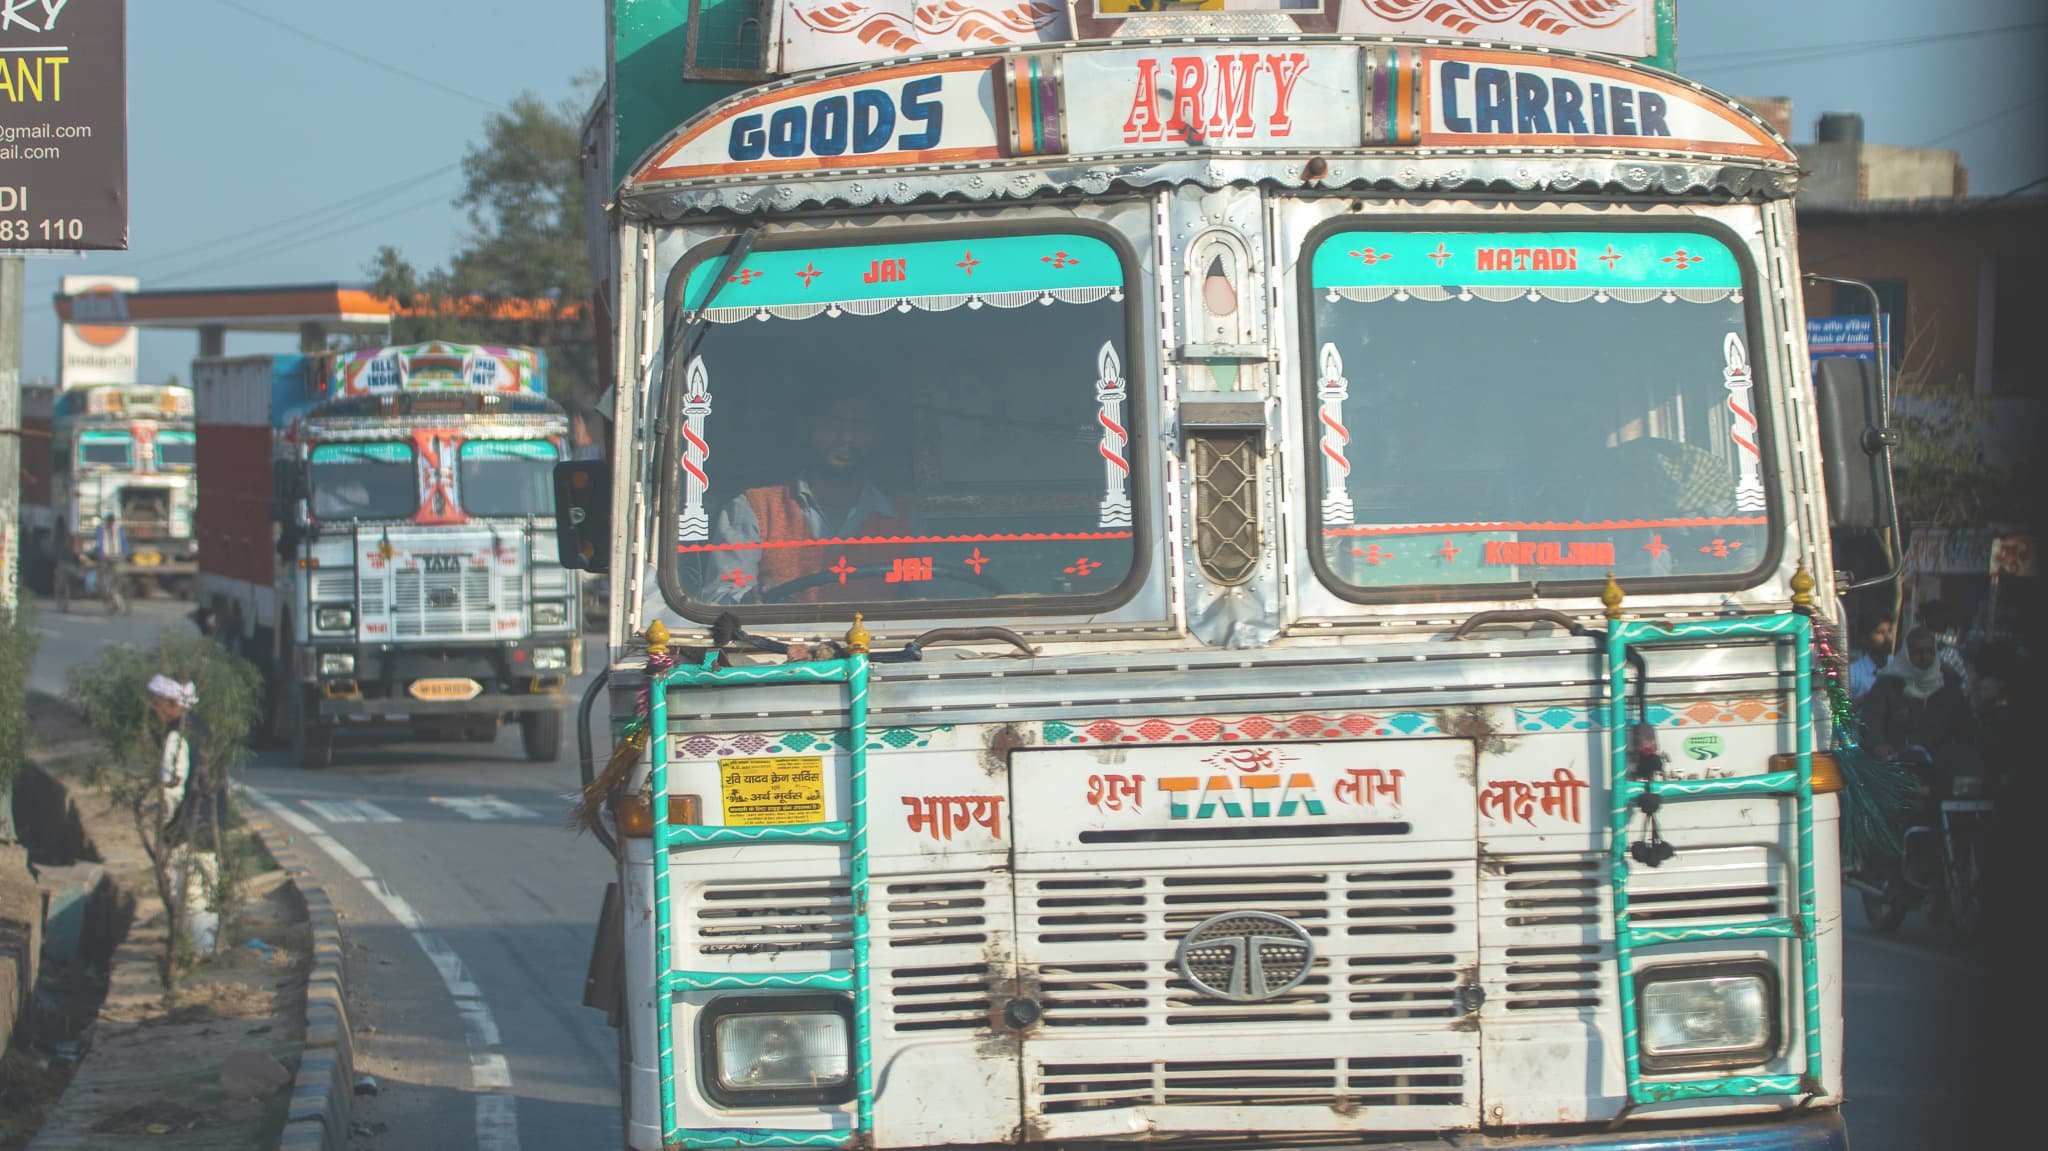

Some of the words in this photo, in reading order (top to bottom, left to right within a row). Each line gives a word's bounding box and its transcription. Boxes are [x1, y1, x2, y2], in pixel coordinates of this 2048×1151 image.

[729, 74, 943, 161] GOODS
[1123, 53, 1309, 143] ARMY
[1442, 60, 1671, 138] CARRIER
[0, 219, 30, 241] 83
[39, 218, 83, 241] 110
[423, 557, 461, 570] TATA
[1086, 774, 1146, 815] शुभ
[1159, 773, 1327, 820] TATA
[1334, 768, 1405, 807] लाभ
[1479, 767, 1590, 827] लक्ष्मी
[901, 794, 1005, 841] भाग्य
